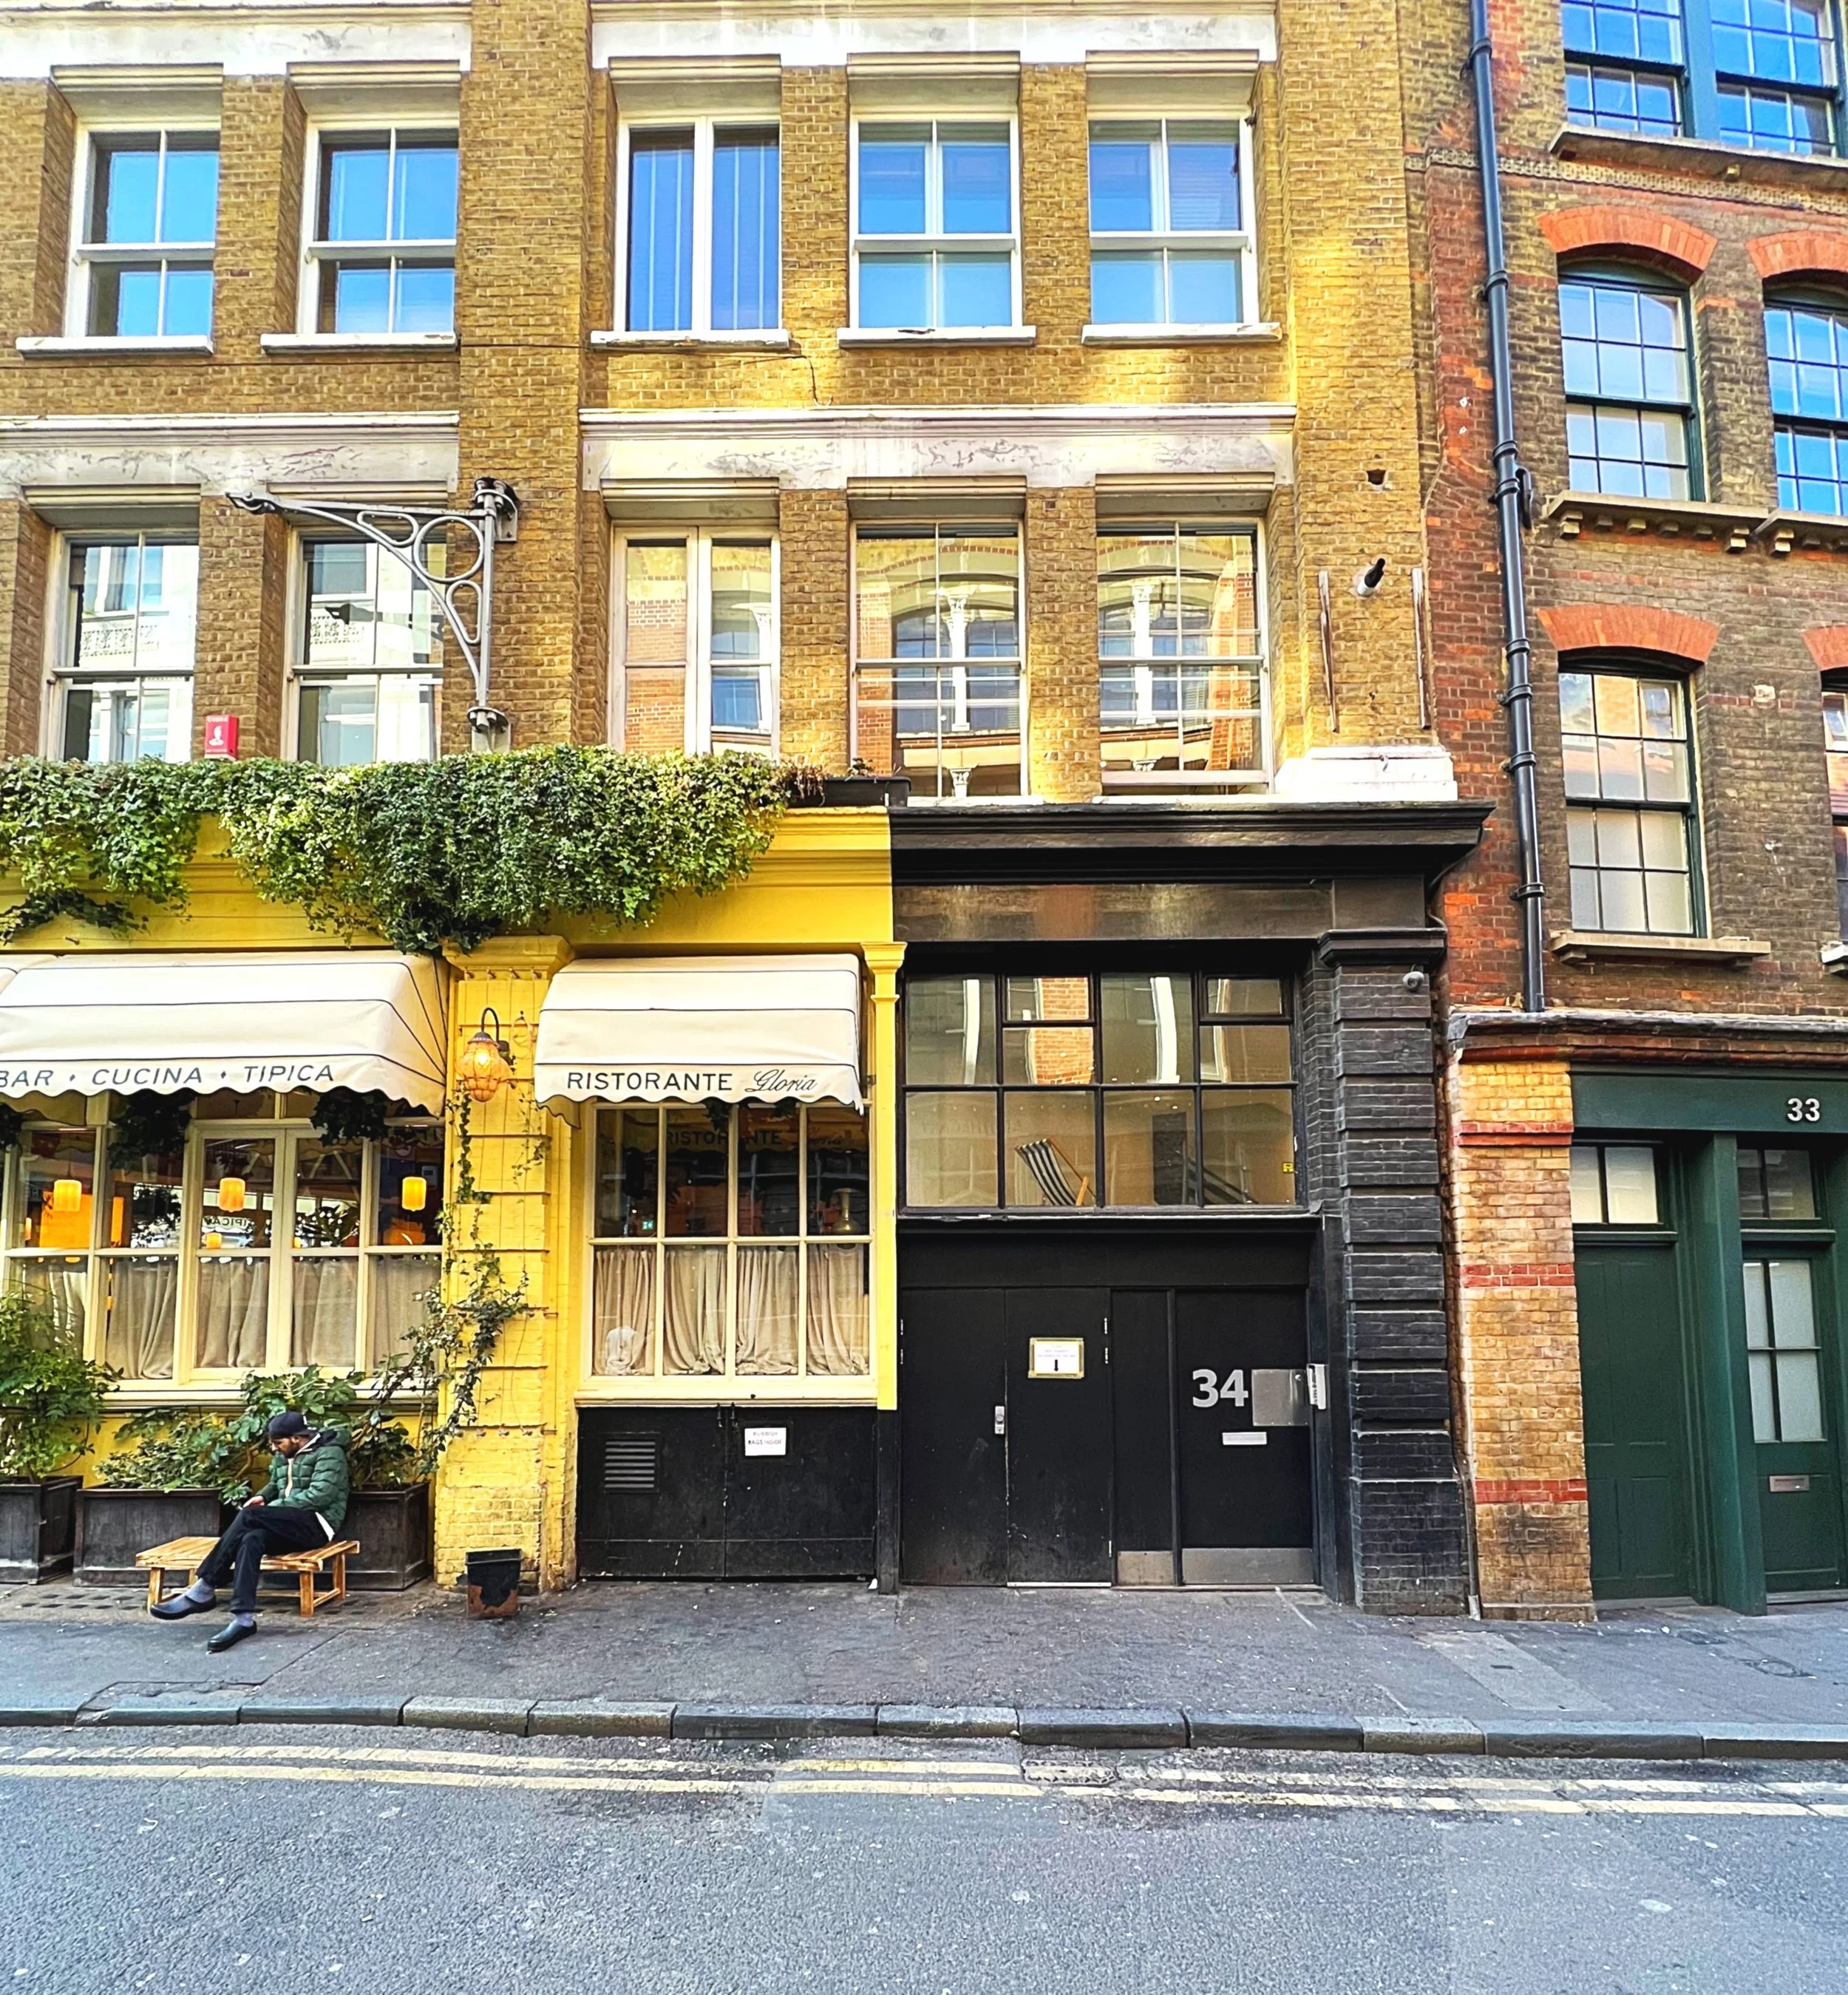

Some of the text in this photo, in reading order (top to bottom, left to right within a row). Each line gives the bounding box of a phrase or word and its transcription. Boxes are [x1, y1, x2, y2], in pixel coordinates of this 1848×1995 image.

[92, 1068, 202, 1085] CUCINA
[244, 1064, 334, 1082] TIPICA
[567, 1069, 818, 1092] RISTORANTE Gloria
[1787, 1098, 1820, 1121] 33
[1192, 1369, 1249, 1407] 34
